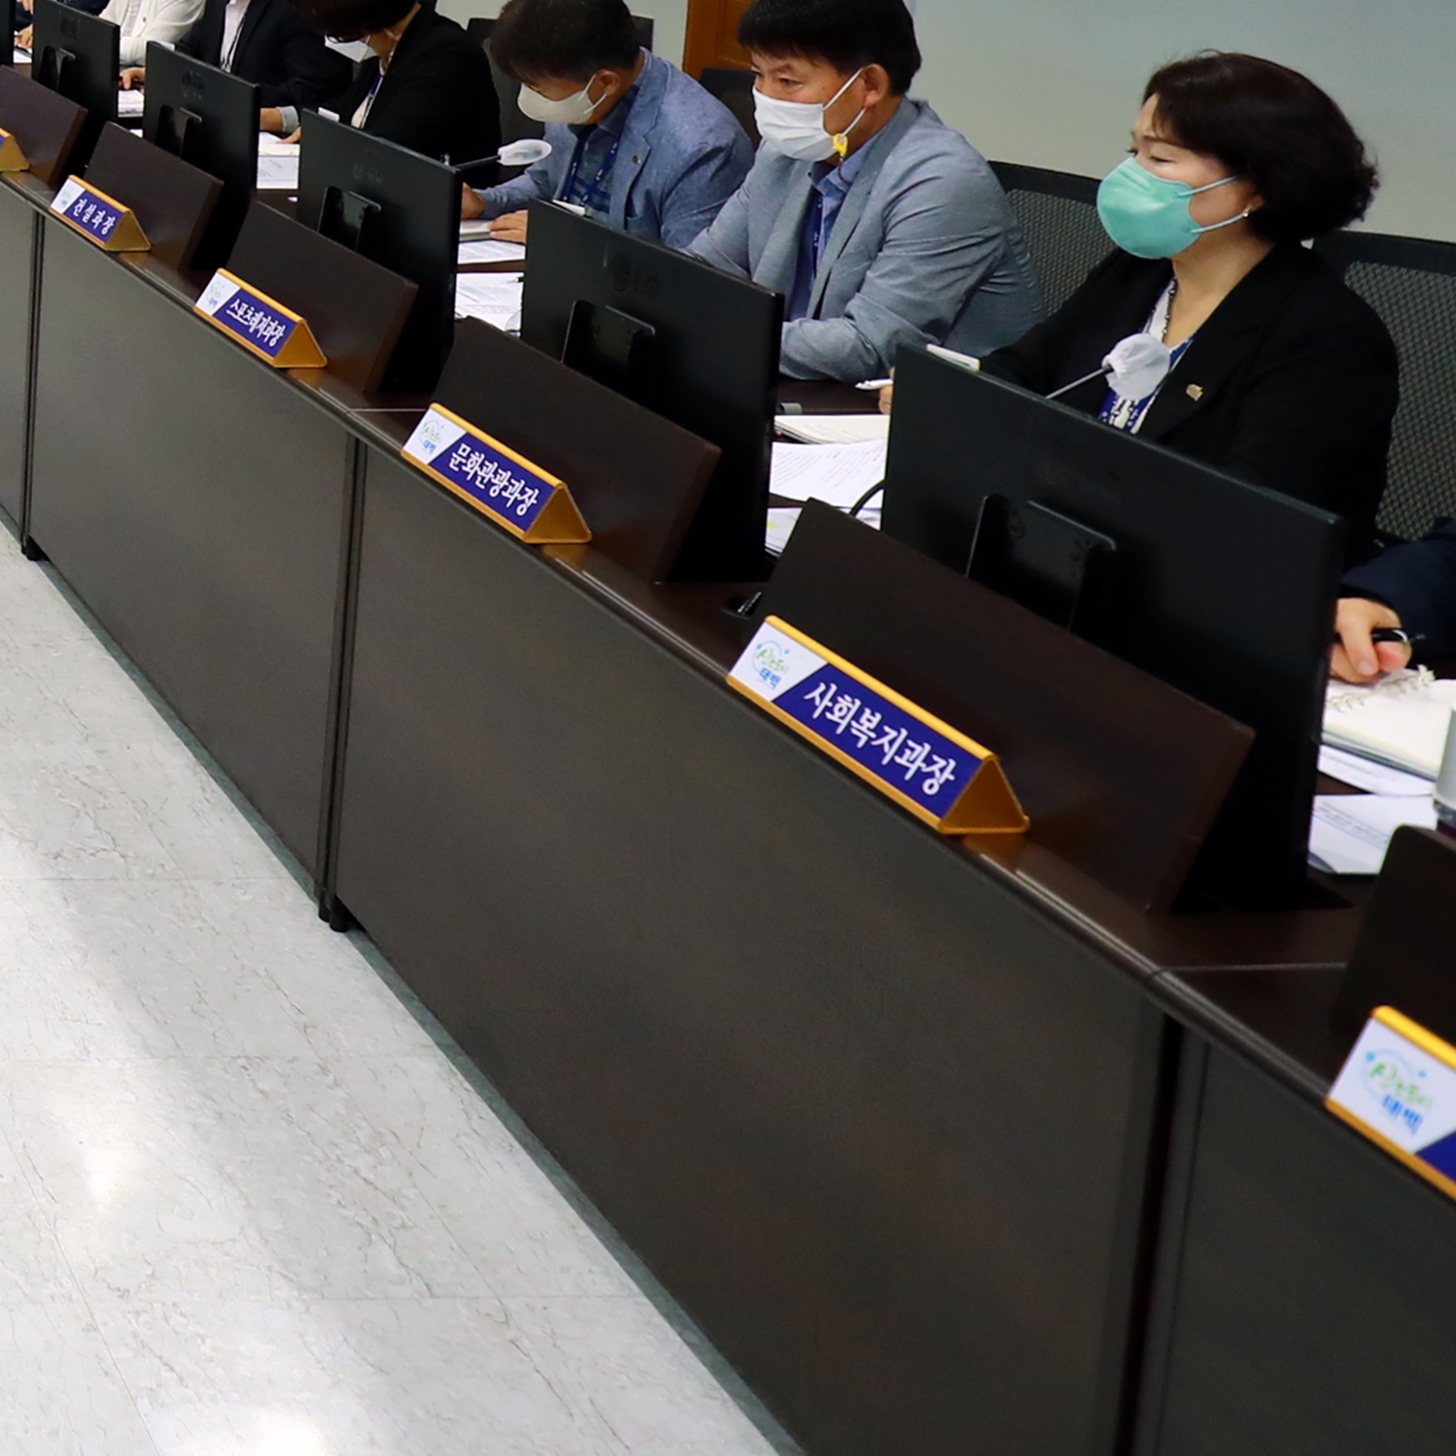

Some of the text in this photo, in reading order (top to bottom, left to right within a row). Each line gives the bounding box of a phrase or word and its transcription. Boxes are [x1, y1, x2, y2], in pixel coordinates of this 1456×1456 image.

[73, 198, 116, 235] 건설과장
[226, 299, 286, 347] 스포츠레저과장
[448, 443, 539, 516] 문화관광과장
[803, 682, 957, 795] 사회복지과장
